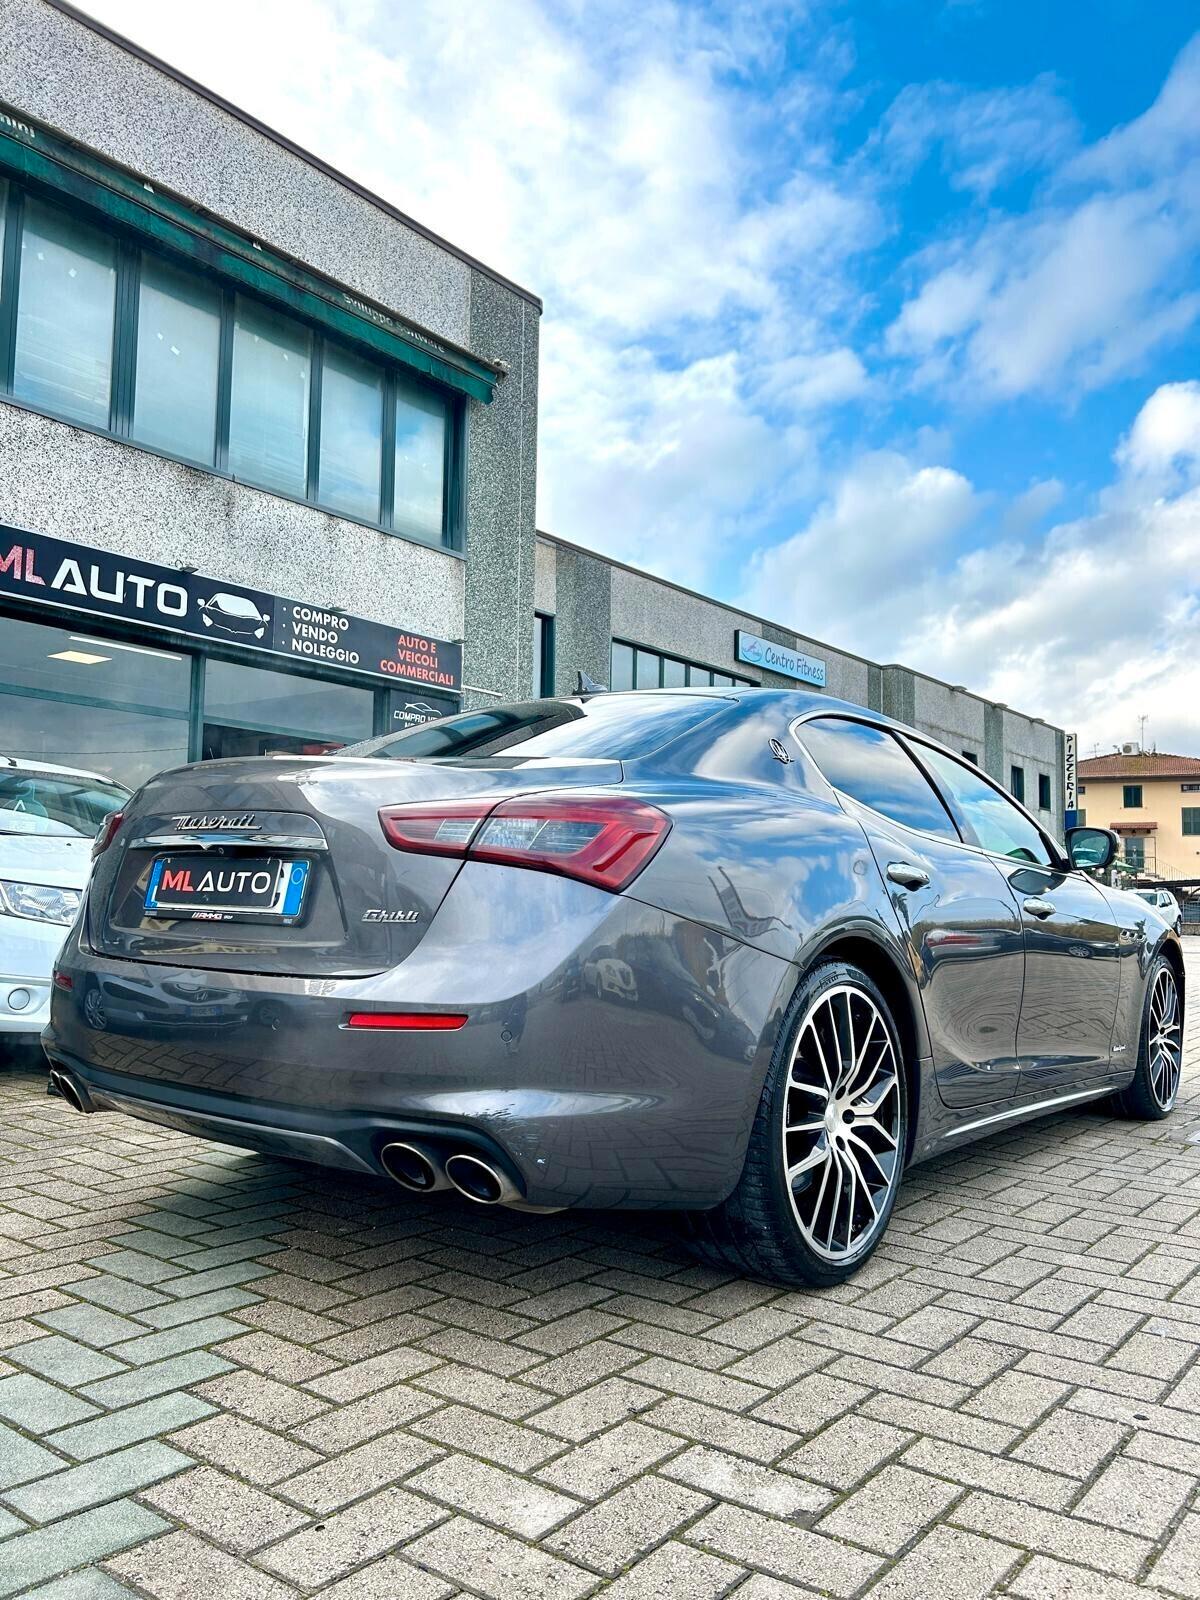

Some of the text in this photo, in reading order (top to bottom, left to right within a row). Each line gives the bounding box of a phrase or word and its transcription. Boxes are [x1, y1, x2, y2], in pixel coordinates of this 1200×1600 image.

[50, 558, 188, 617] AUTO
[292, 606, 349, 631] COMPRO
[292, 621, 338, 644] VENDO
[398, 634, 437, 654] AUTO E
[291, 638, 360, 664] NOLEGGIO
[397, 649, 438, 669] VEICOLI
[380, 659, 454, 686] COMMERCIALI
[765, 647, 824, 681] Centro Fitness
[393, 710, 426, 723] COMPRO
[1065, 735, 1075, 809] PIZZERIA
[171, 813, 263, 830] Maserati
[161, 870, 271, 894] ML AUTO
[361, 909, 420, 923] Ghibli
